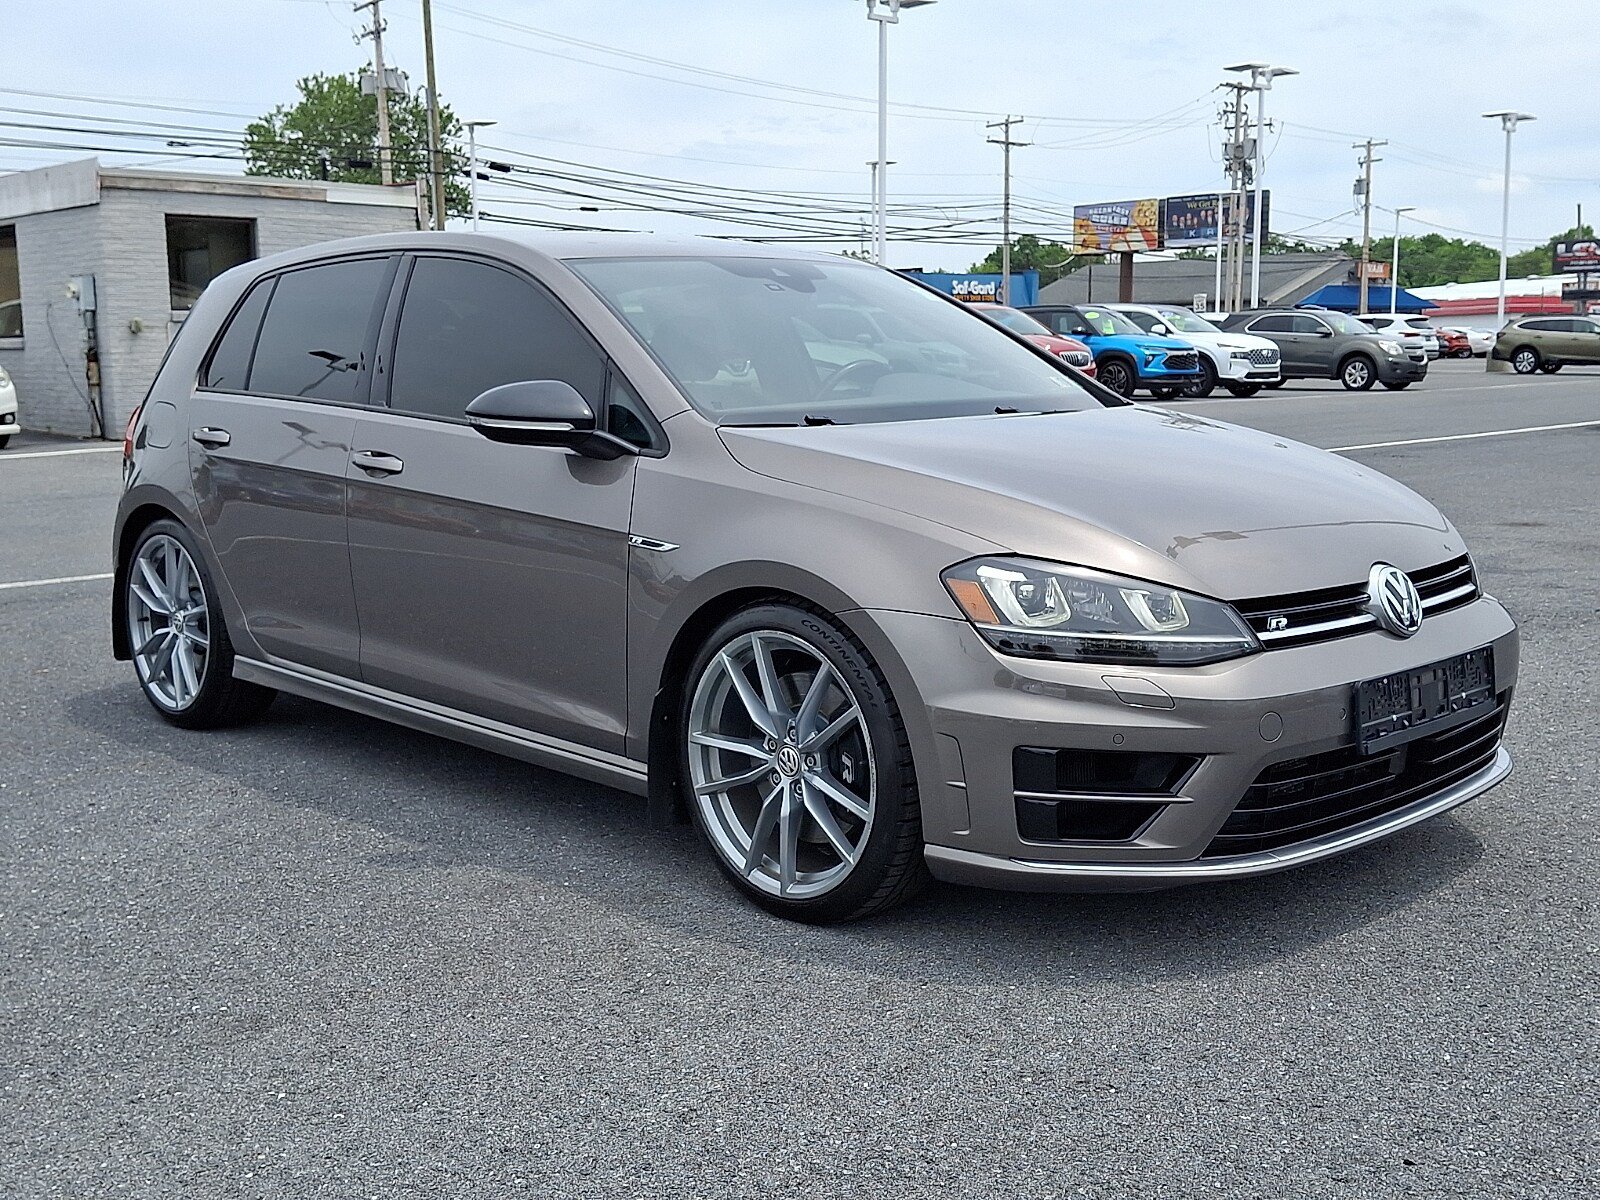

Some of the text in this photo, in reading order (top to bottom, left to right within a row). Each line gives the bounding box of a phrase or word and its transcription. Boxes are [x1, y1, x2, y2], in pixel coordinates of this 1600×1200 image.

[952, 280, 995, 295] Saf-Gard
[1267, 615, 1288, 631] R
[801, 618, 878, 709] CONTINENTAL
